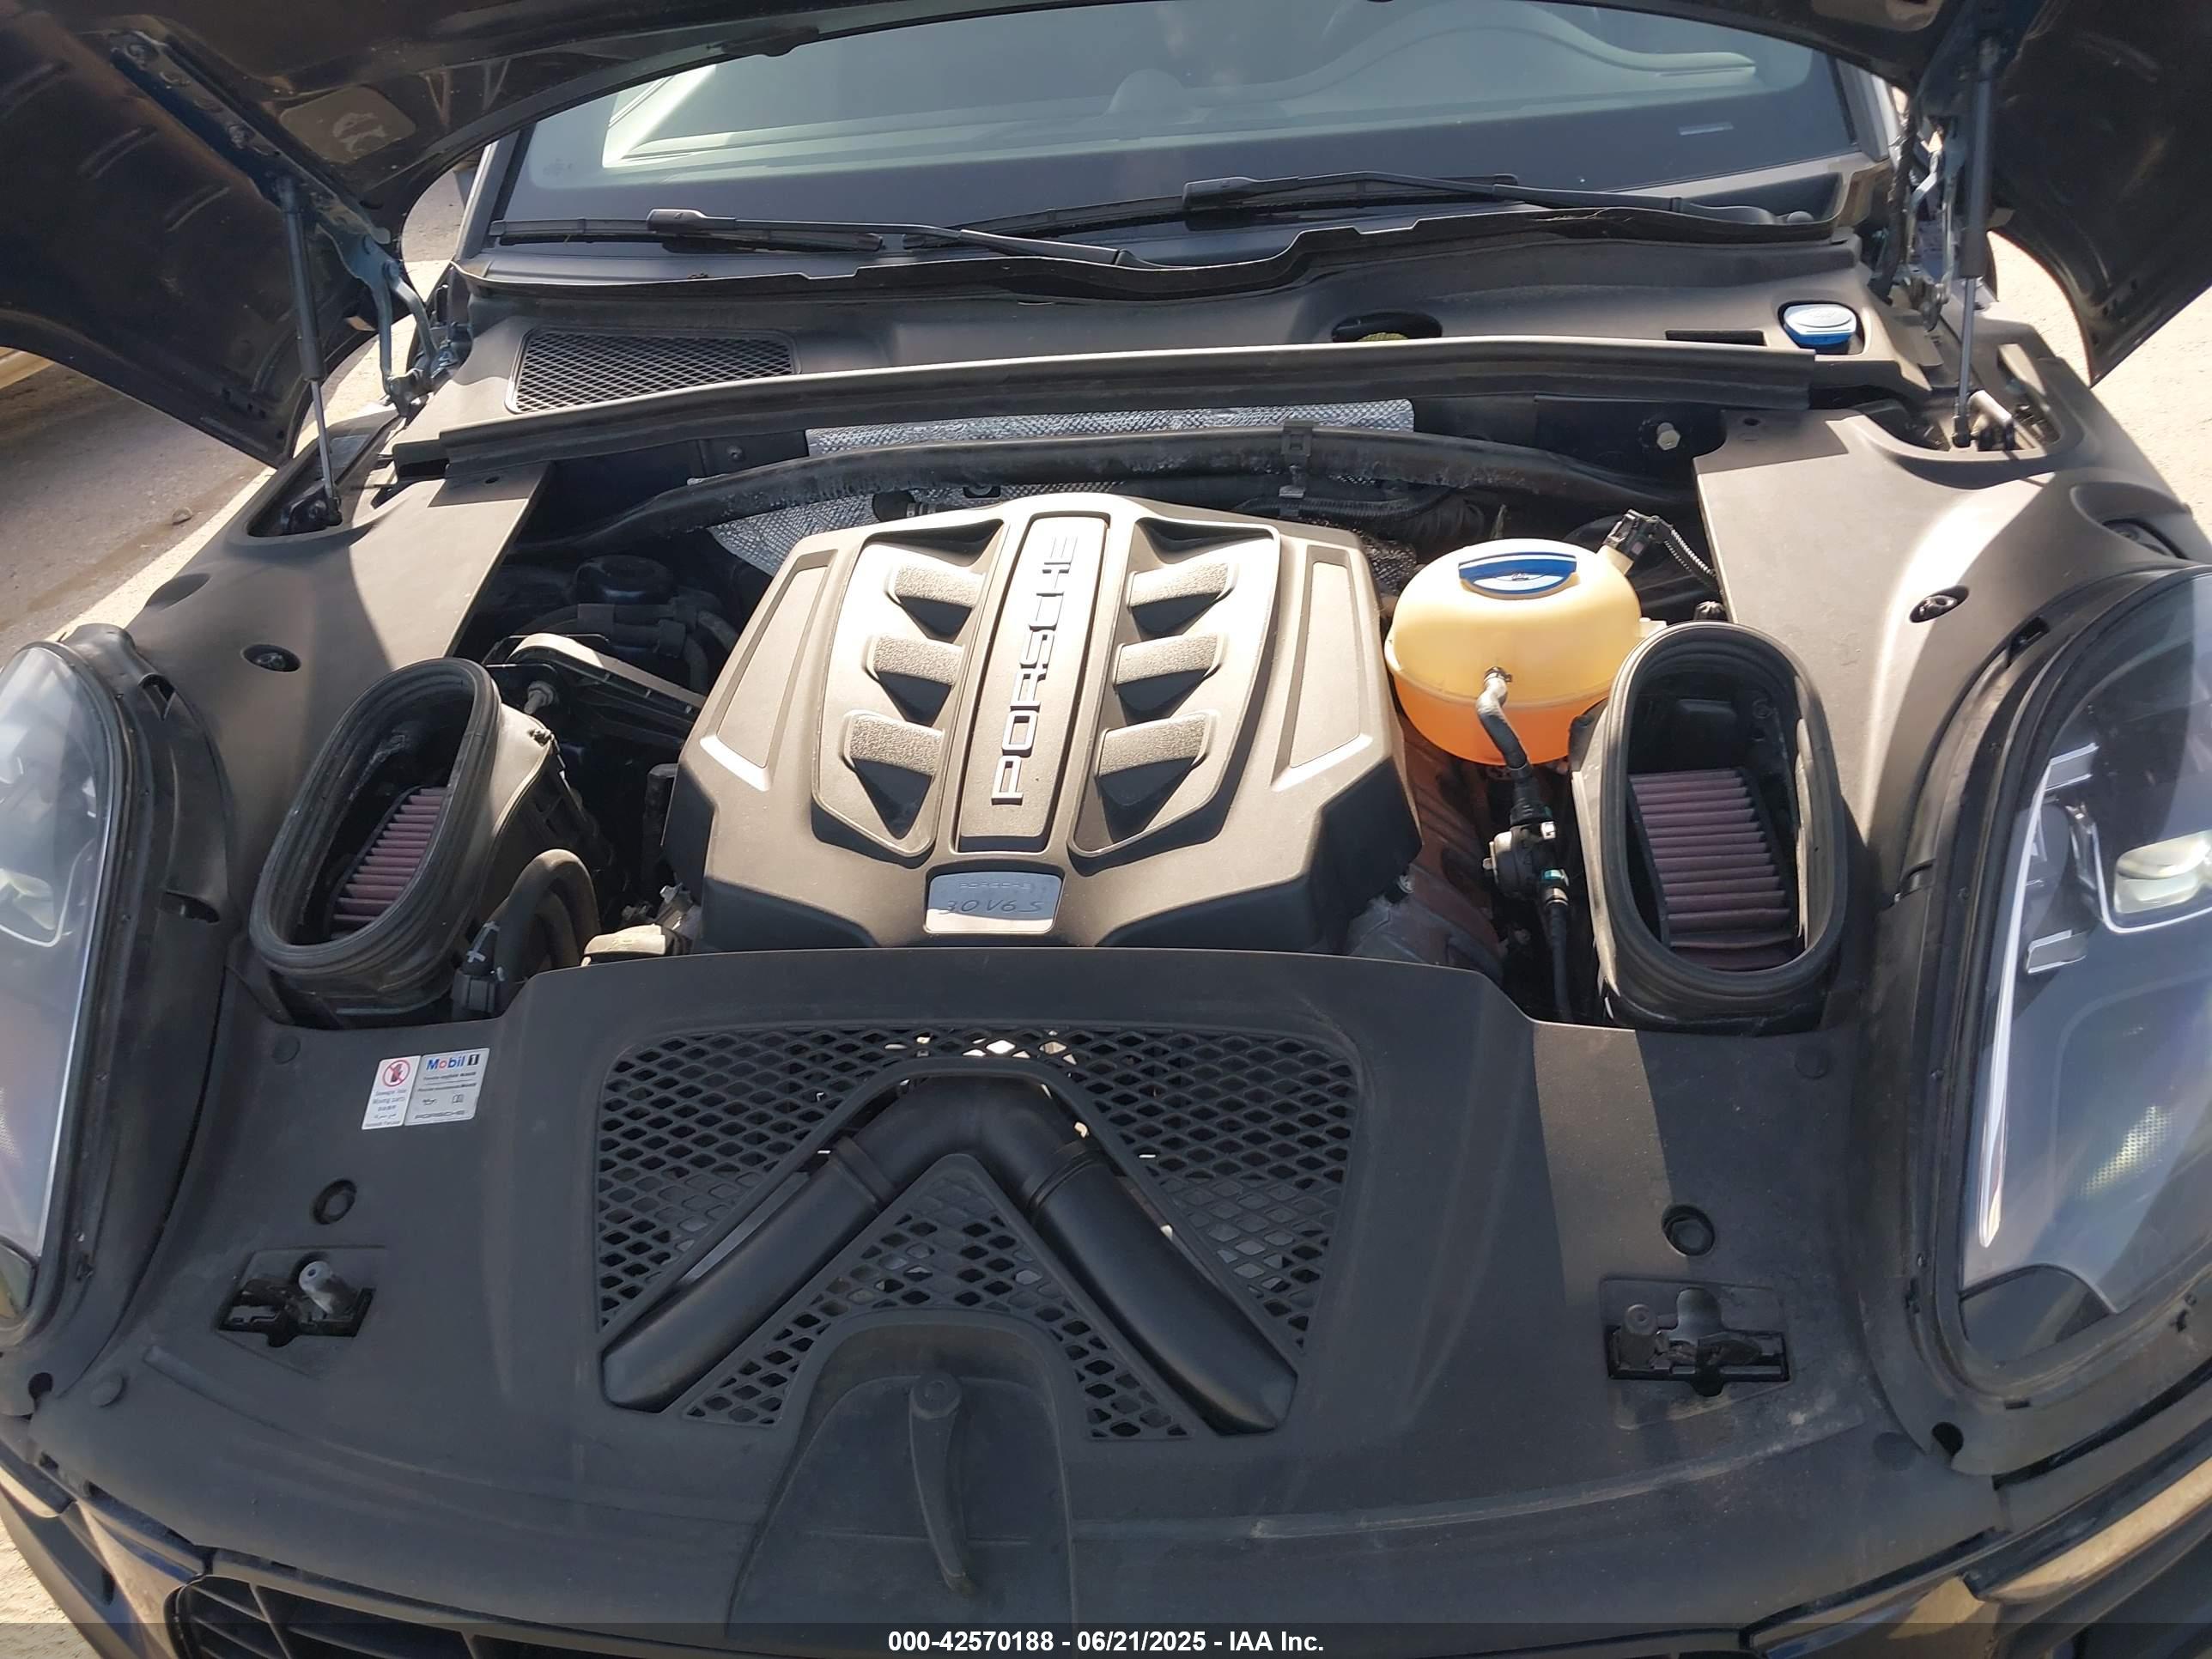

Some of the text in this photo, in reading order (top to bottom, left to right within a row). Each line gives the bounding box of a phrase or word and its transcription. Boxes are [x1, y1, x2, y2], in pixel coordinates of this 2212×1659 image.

[991, 537, 1078, 805] PORSCHE
[426, 1054, 481, 1071] Mobil 1
